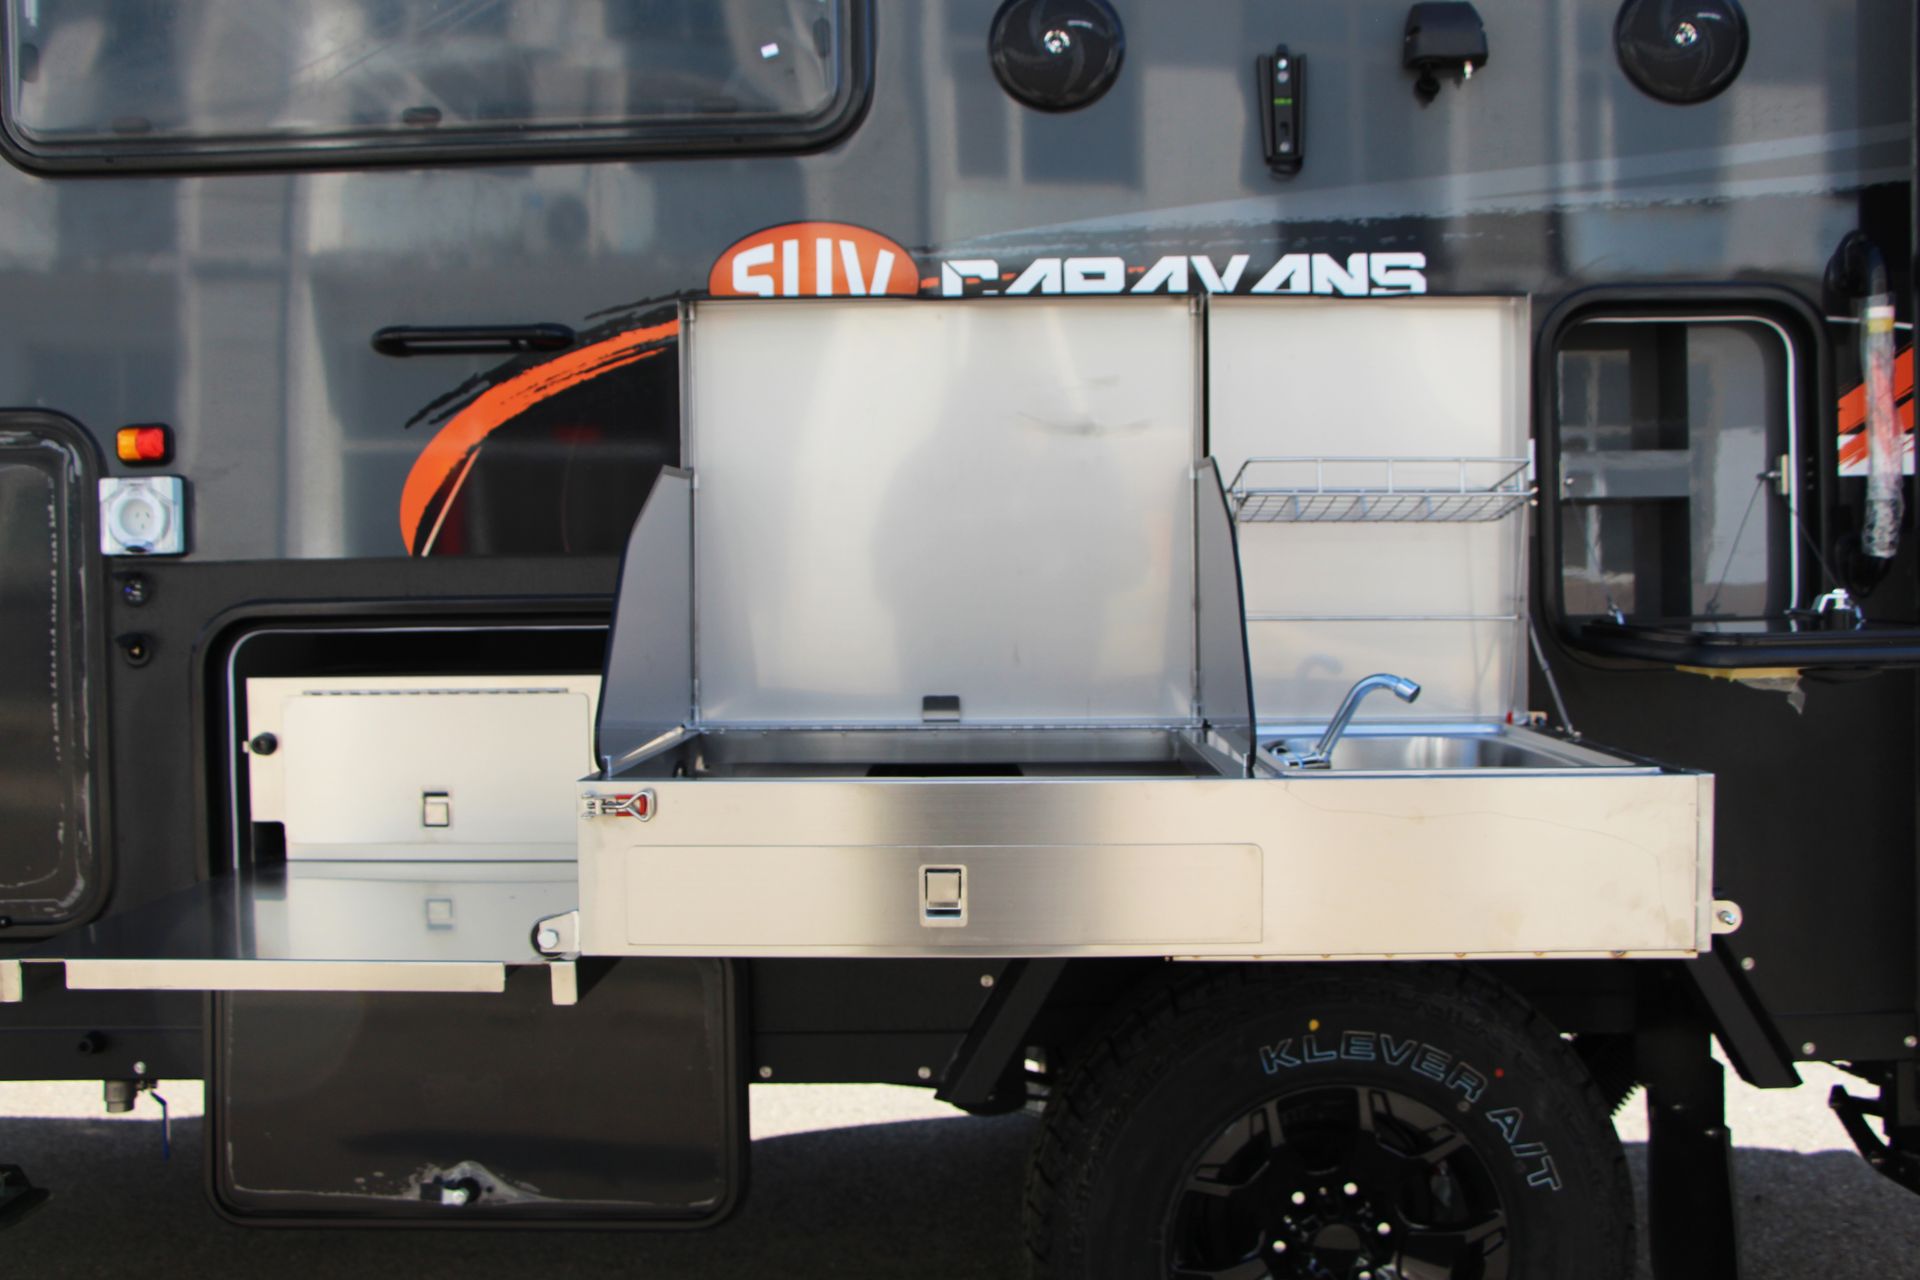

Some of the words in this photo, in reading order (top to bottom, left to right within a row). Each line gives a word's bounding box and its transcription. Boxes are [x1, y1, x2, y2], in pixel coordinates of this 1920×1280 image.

[731, 238, 894, 296] SUV
[1260, 1031, 1488, 1103] KLEVER
[1487, 1106, 1563, 1192] A/T
